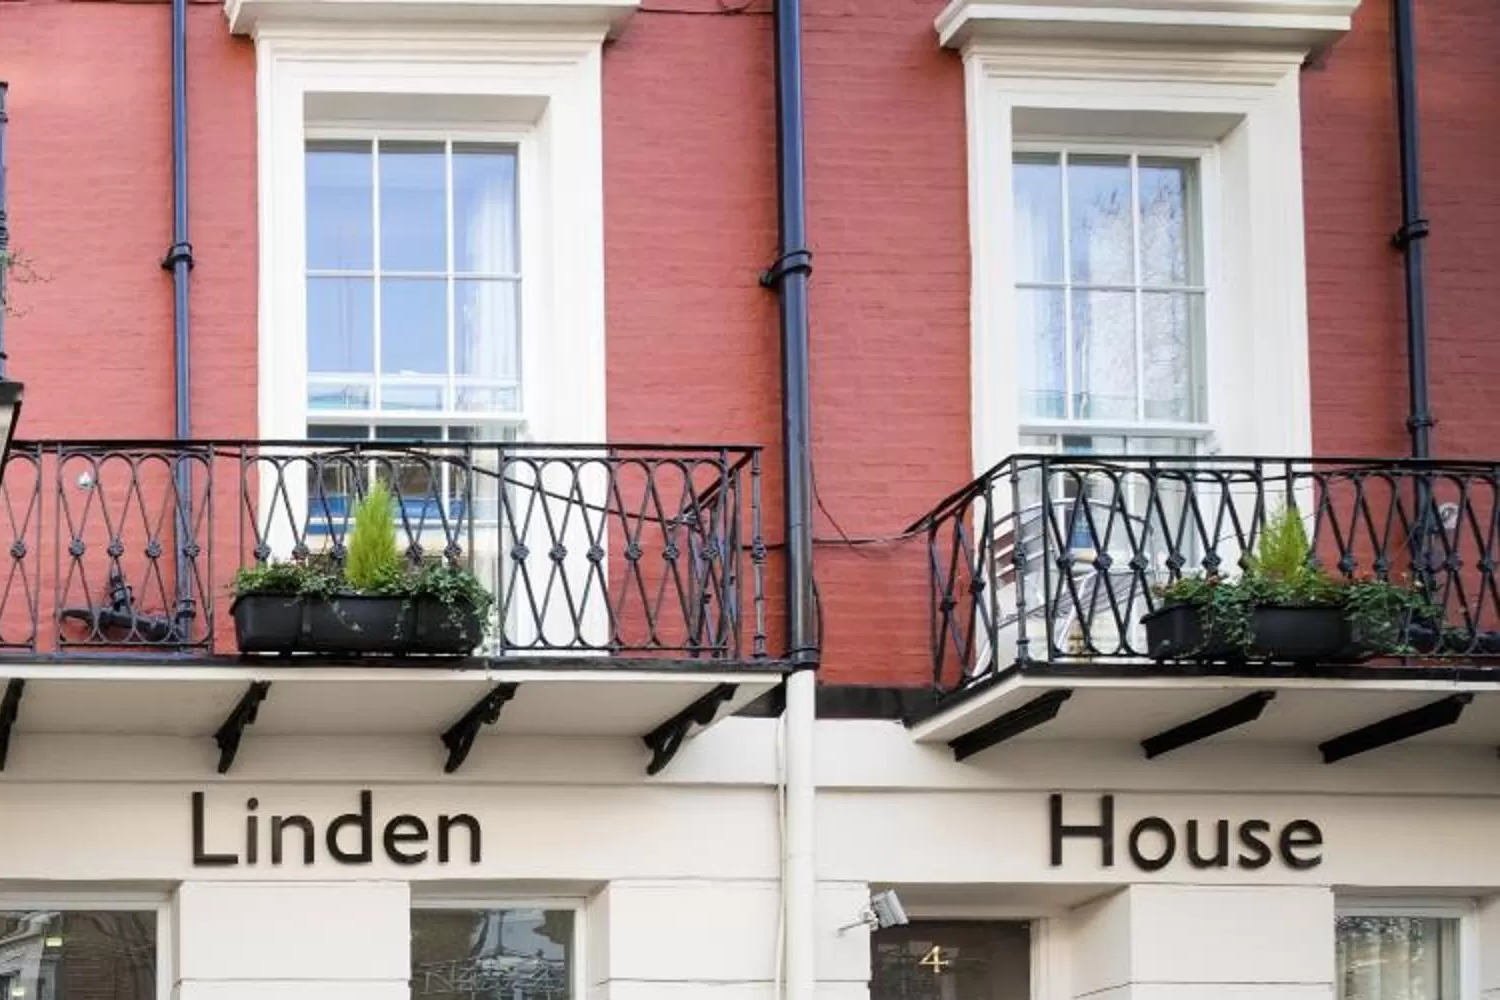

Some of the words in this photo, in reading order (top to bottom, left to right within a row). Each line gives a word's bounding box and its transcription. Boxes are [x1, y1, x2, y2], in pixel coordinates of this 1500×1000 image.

[191, 789, 482, 866] Linden
[1049, 793, 1324, 872] House
[918, 945, 949, 973] 4
